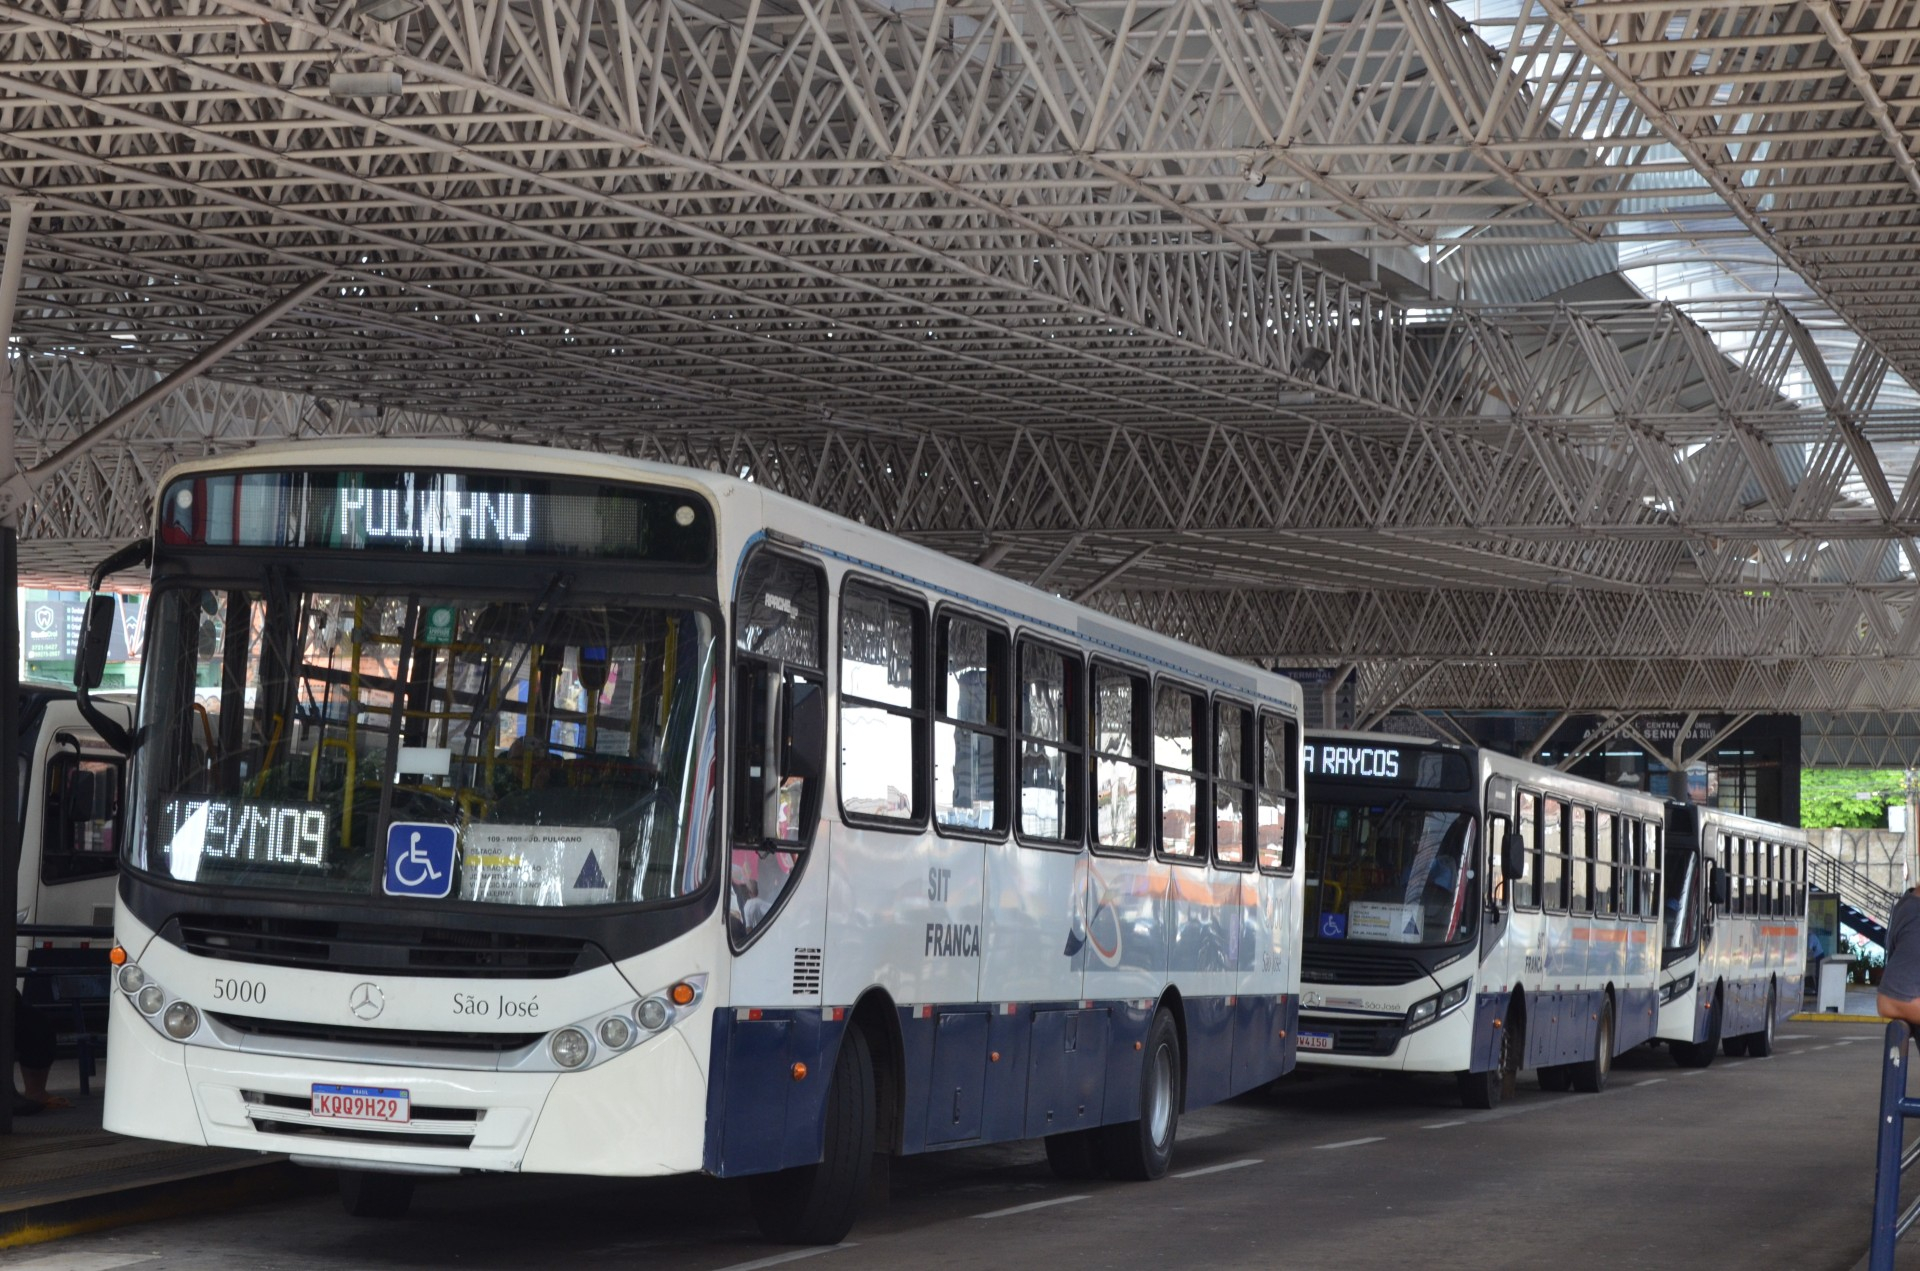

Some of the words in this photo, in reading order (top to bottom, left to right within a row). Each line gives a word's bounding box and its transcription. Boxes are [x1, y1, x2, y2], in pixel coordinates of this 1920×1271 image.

[1289, 671, 1332, 679] TERMINAL
[1644, 730, 1680, 739] SENN
[1322, 746, 1399, 778] RAYCOS
[928, 867, 951, 902] SIT
[925, 923, 980, 957] FRANCA
[213, 978, 267, 1004] 5000
[453, 992, 490, 1015] São
[497, 995, 539, 1019] José
[1365, 1001, 1381, 1009] São
[1383, 1002, 1401, 1010] José
[320, 1095, 398, 1118] KQQ9H29
